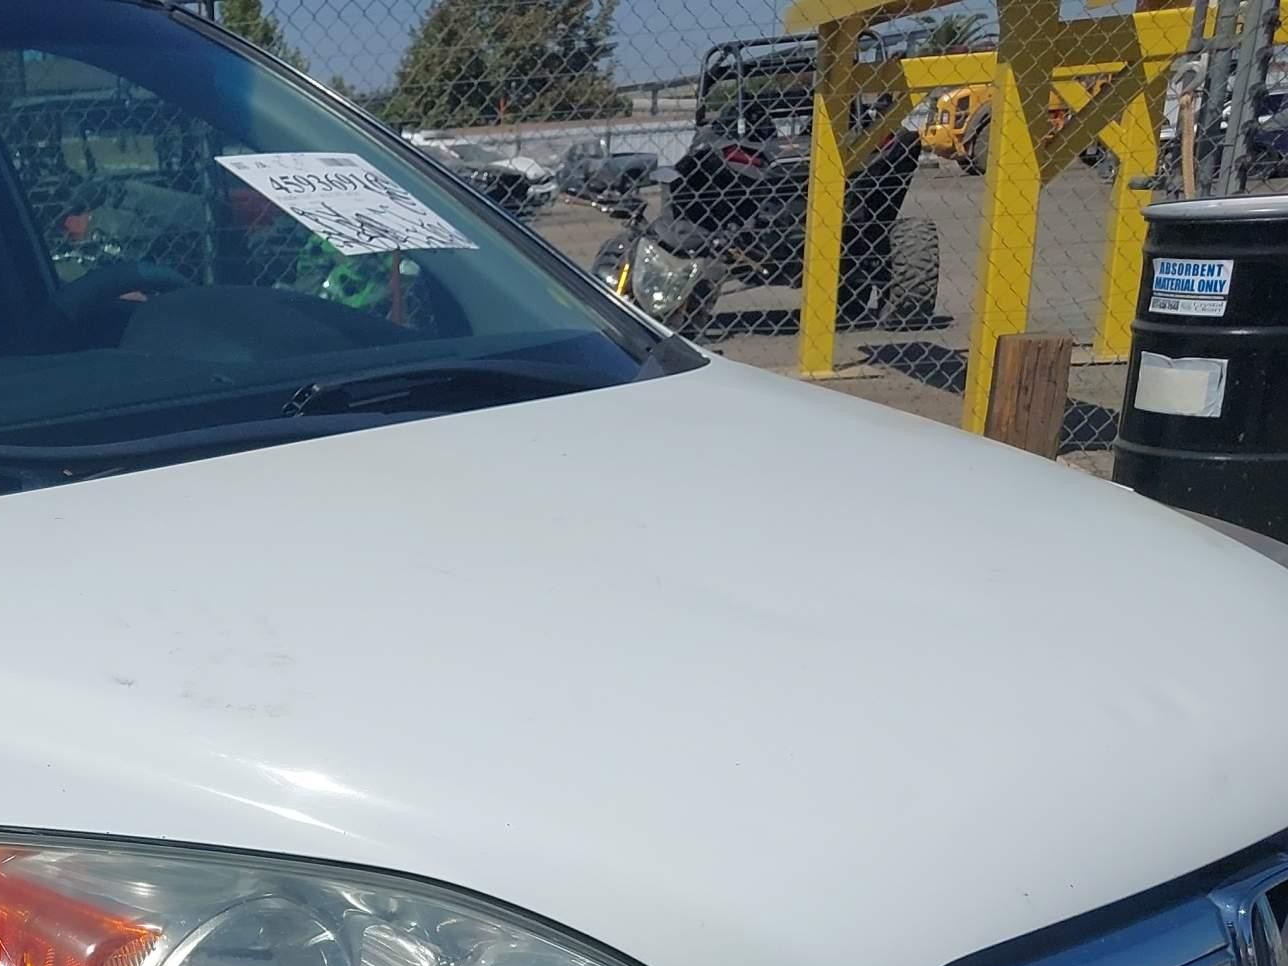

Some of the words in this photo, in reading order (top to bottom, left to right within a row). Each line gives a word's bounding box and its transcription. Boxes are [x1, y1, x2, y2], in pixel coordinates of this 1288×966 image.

[1159, 262, 1224, 277] ABSORBENT
[1155, 277, 1196, 292] MATERIAL
[1197, 279, 1227, 293] ONLY
